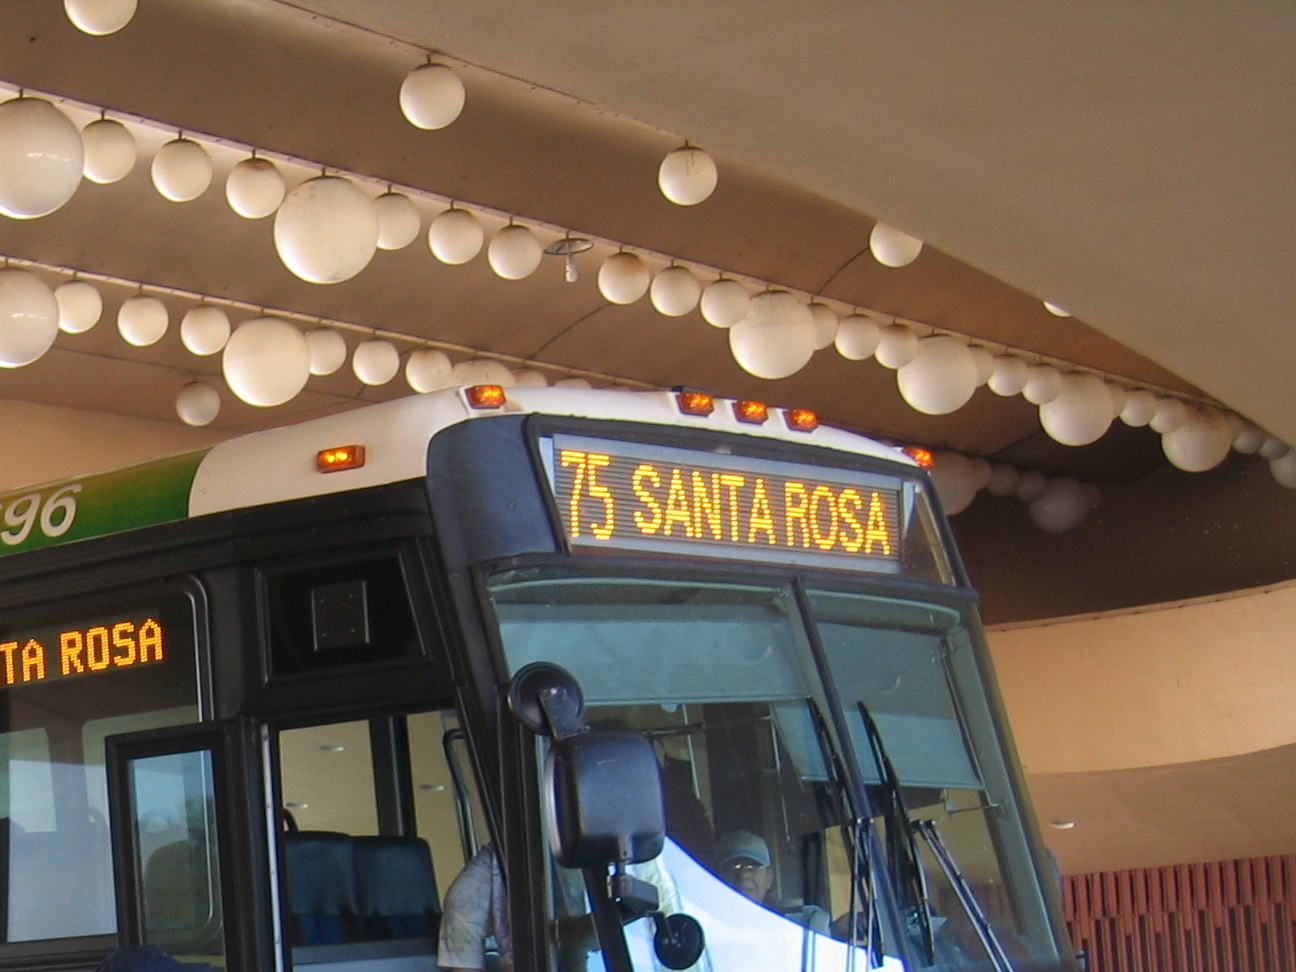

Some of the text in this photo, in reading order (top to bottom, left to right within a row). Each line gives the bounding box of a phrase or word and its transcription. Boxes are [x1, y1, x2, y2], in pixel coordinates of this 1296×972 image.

[561, 449, 891, 555] 75 SANTA ROSA
[60, 618, 164, 676] ROSA
